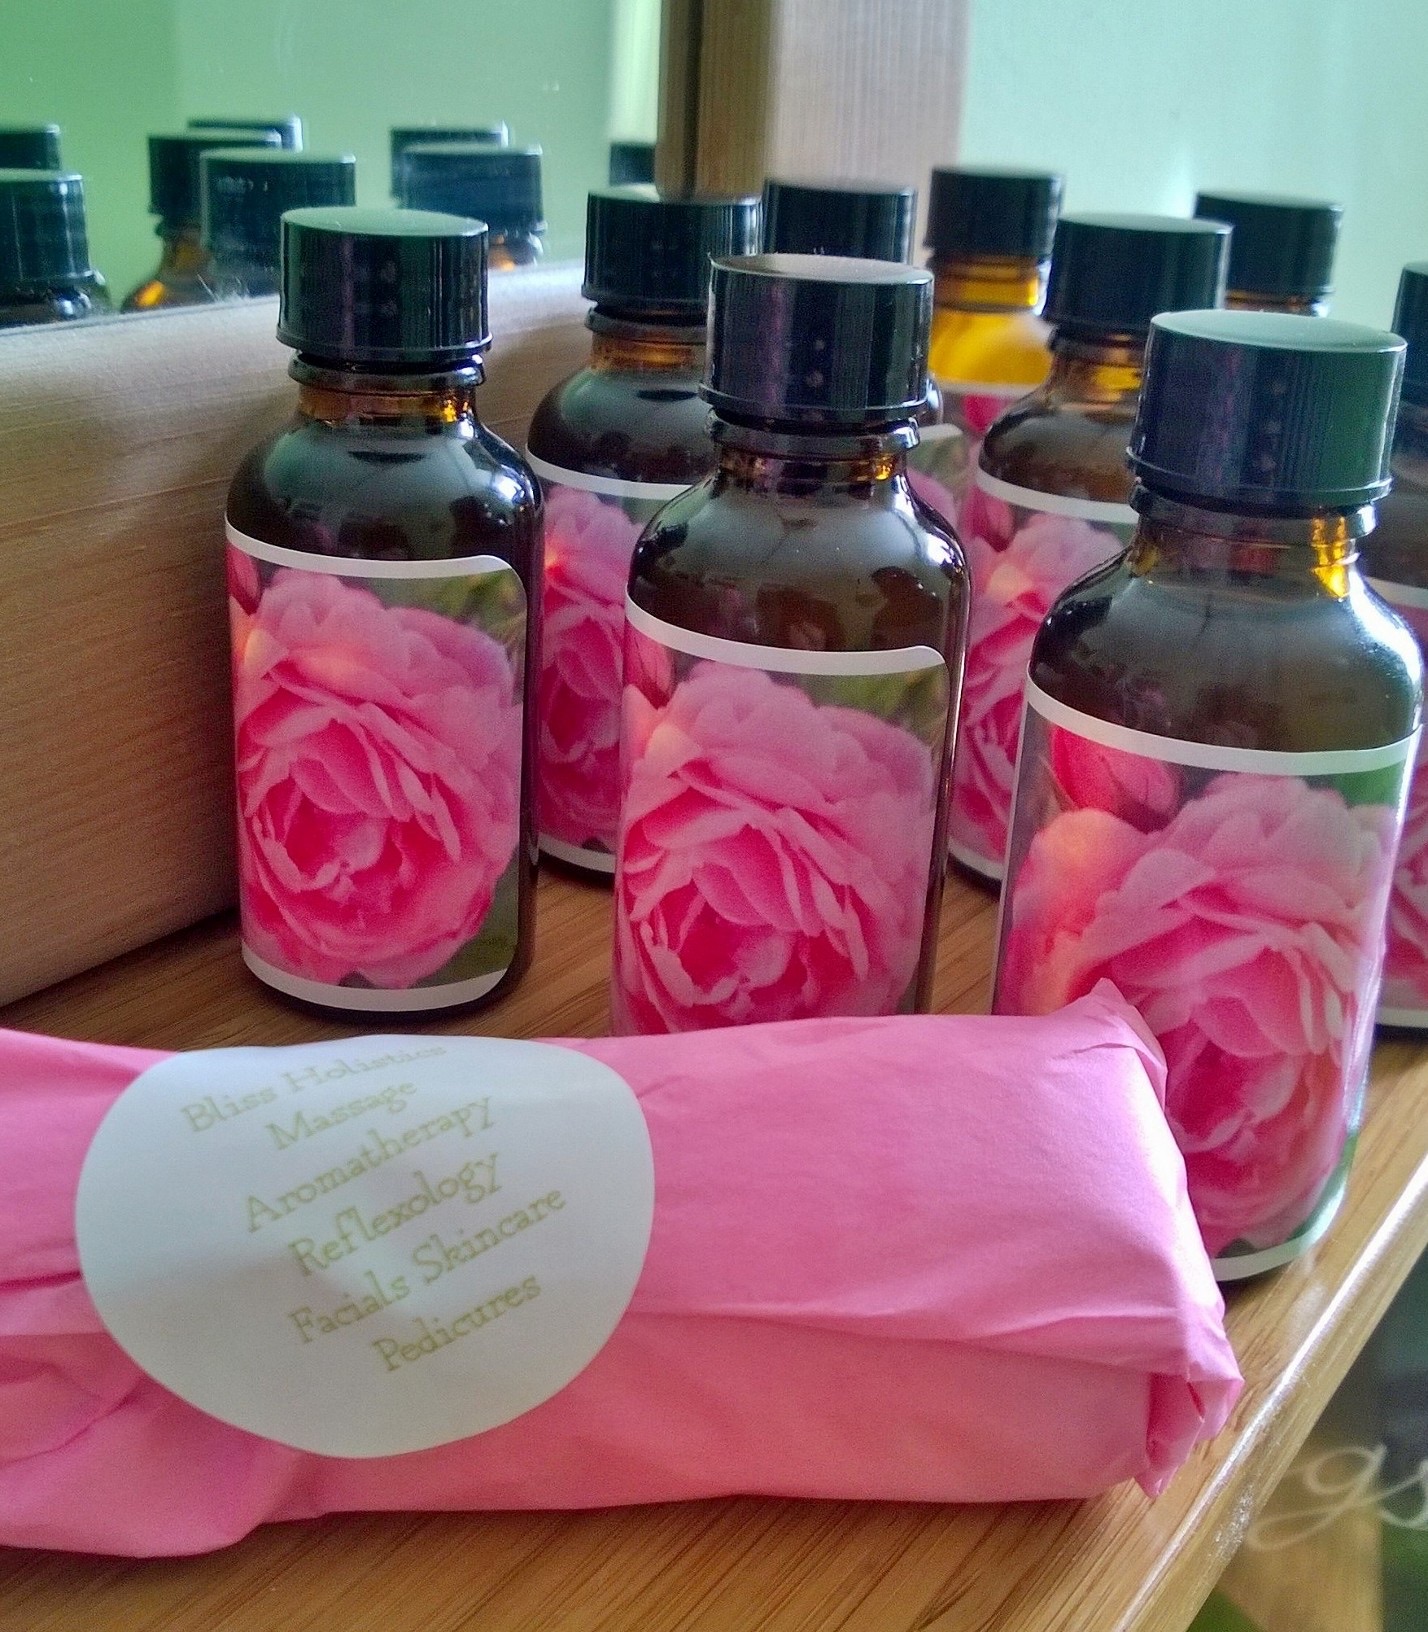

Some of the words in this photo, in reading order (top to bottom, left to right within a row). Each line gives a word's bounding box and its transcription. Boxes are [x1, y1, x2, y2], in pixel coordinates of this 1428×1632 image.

[181, 1085, 276, 1132] Bliss
[283, 1046, 447, 1092] Holistics
[266, 1080, 418, 1150] Massage
[246, 1097, 494, 1233] Aromatherapy
[288, 1153, 502, 1276] Reflexology
[288, 1271, 410, 1343] Facials
[412, 1188, 566, 1284] Skincare
[372, 1275, 541, 1371] Pedicures
